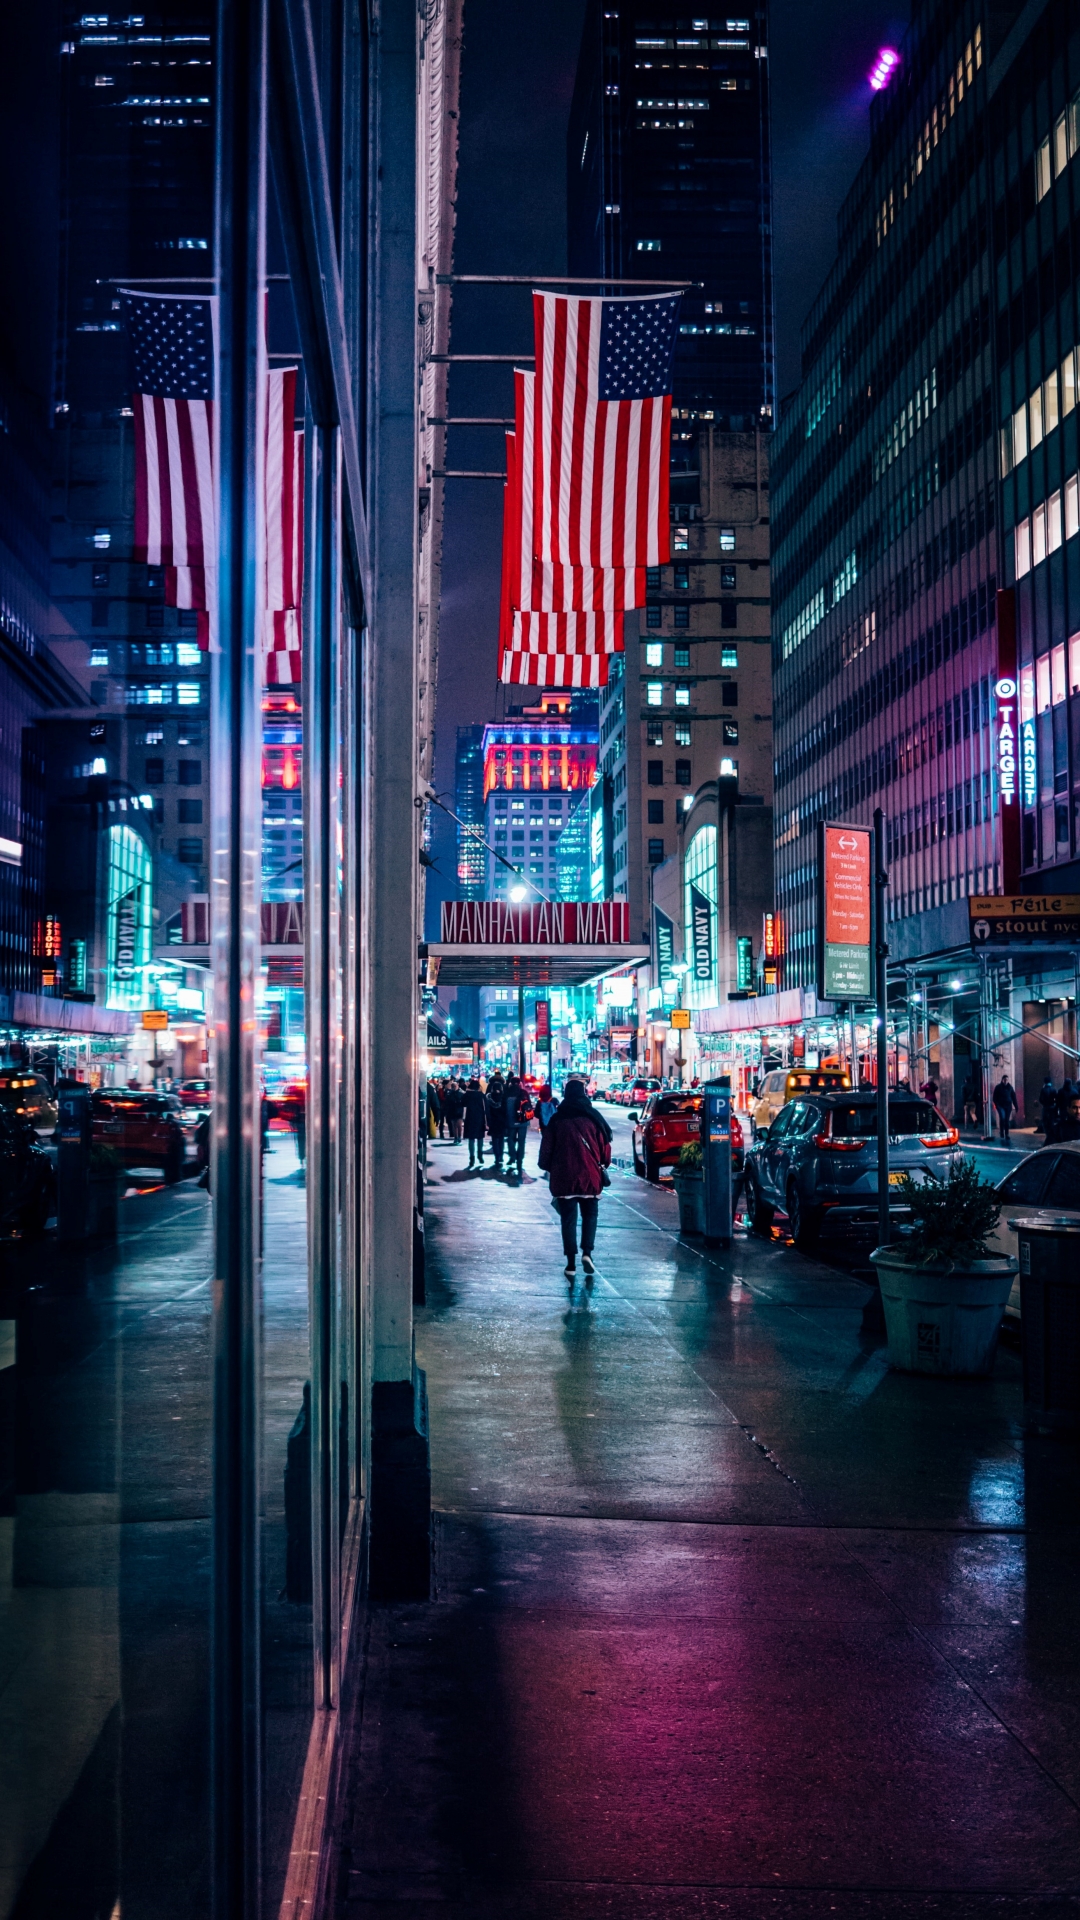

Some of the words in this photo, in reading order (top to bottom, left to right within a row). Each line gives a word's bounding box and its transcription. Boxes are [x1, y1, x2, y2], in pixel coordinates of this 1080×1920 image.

[999, 706, 1015, 805] TARGET
[850, 854, 865, 863] Parking
[834, 873, 861, 881] Commercial
[852, 884, 862, 892] Only
[832, 910, 847, 918] Monday
[850, 911, 864, 920] Saturday
[441, 901, 564, 944] MANHATTAN
[577, 902, 630, 944] MALL
[695, 906, 708, 946] NAVY
[996, 920, 1048, 933] stout
[1054, 923, 1079, 934] nyc
[658, 926, 670, 960] NAVY
[828, 948, 849, 958] Metered
[850, 950, 868, 961] Parking
[696, 948, 710, 978] OLD
[660, 964, 672, 979] LD
[846, 972, 865, 981] Midnight
[428, 1036, 446, 1046] AILS
[716, 1099, 725, 1113] P
